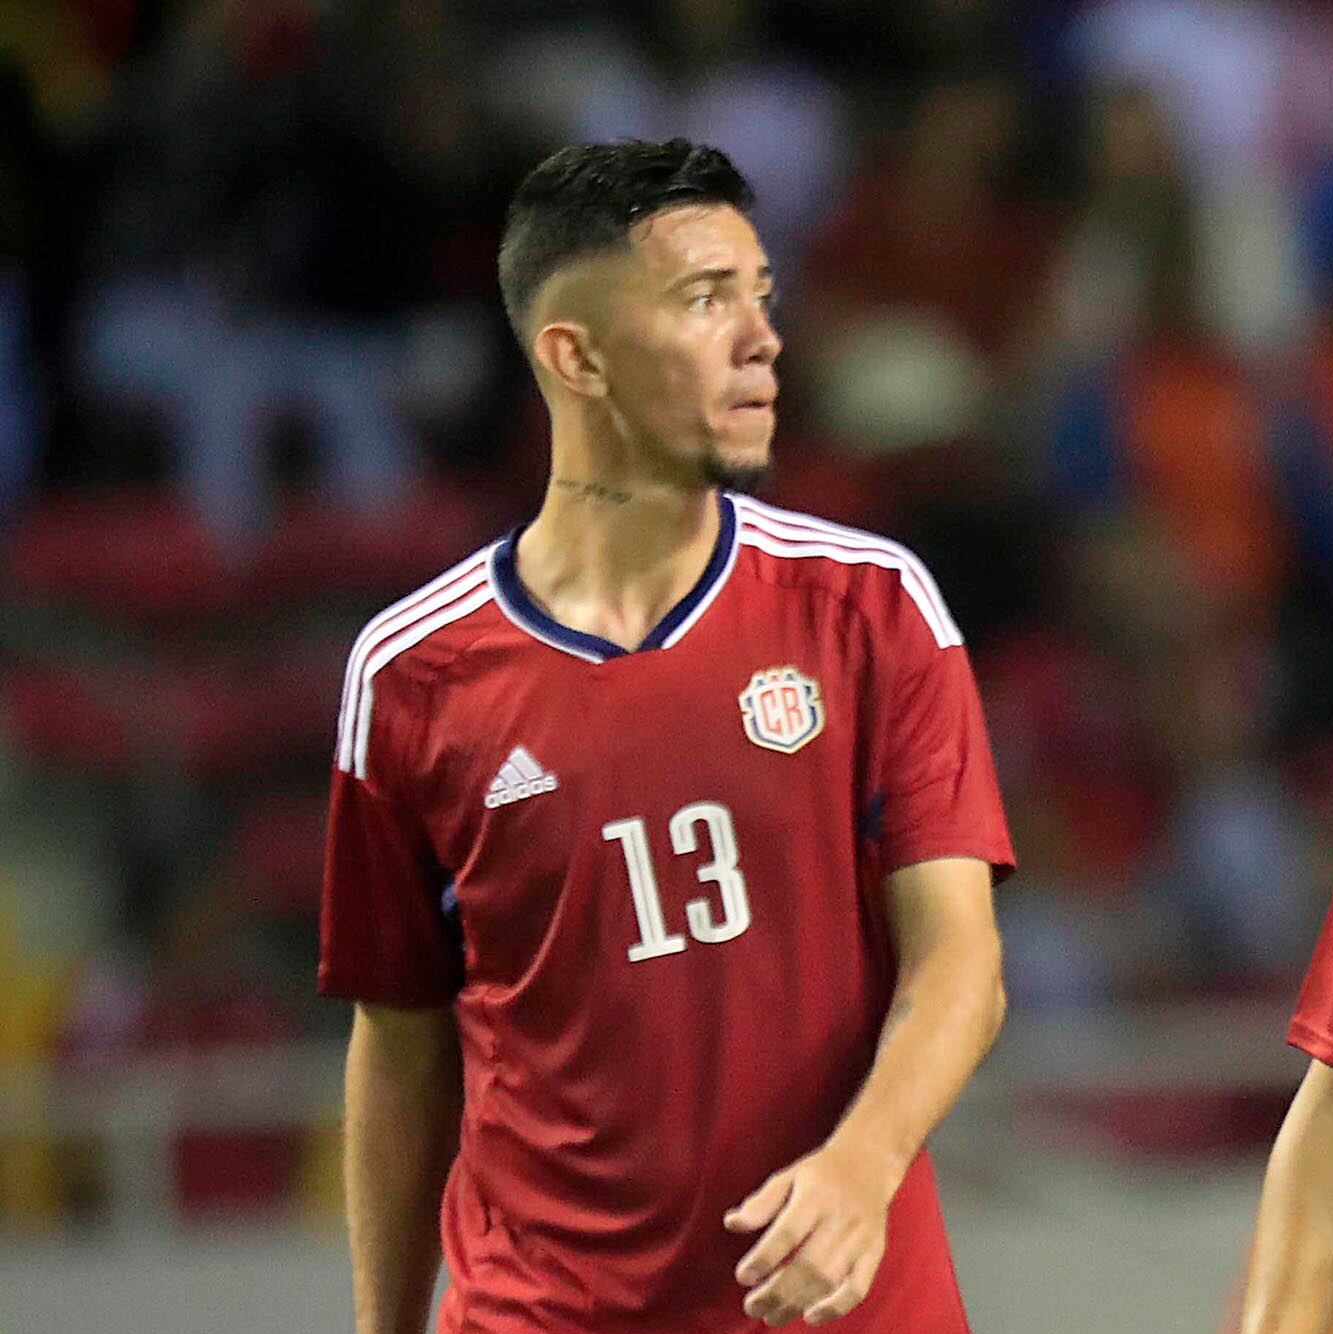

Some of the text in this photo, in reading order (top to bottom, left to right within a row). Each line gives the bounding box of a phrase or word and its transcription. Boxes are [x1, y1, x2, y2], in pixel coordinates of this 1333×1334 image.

[759, 687, 804, 736] CR
[484, 774, 557, 809] adidas
[602, 801, 751, 962] 13
